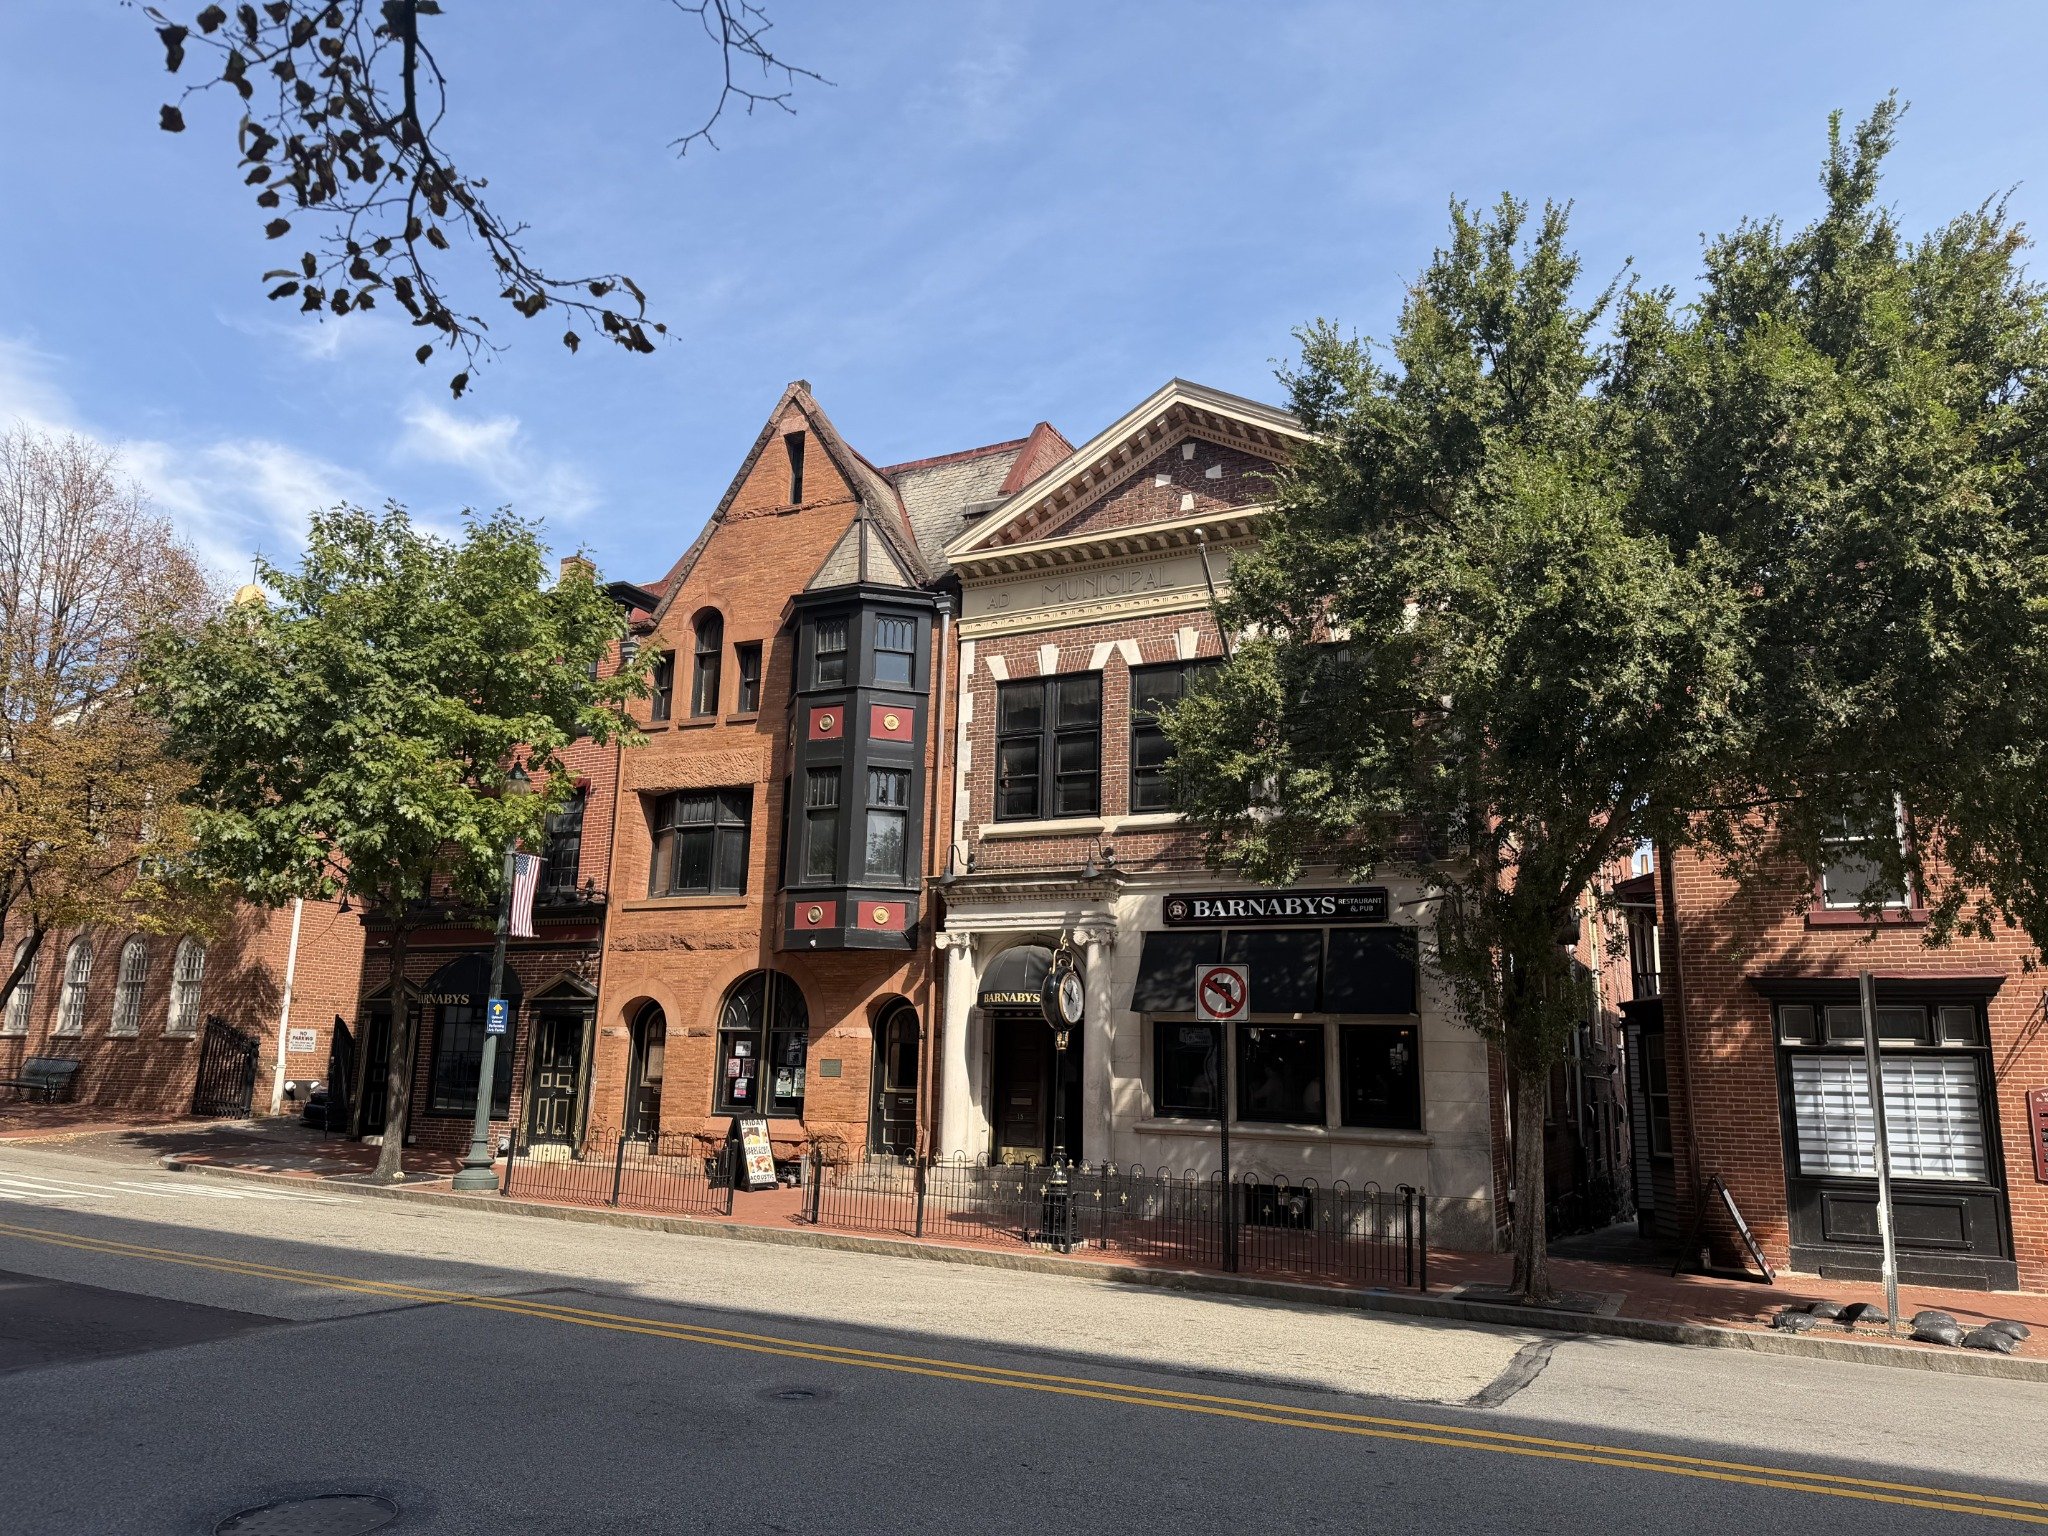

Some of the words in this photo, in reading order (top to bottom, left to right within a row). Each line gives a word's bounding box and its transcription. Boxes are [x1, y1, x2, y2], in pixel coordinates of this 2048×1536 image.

[1041, 565, 1174, 605] MUNICIPAL
[1193, 896, 1336, 917] BARNABYS
[1338, 897, 1382, 905] RESTAURANT
[984, 992, 1041, 1003] BARNABYS
